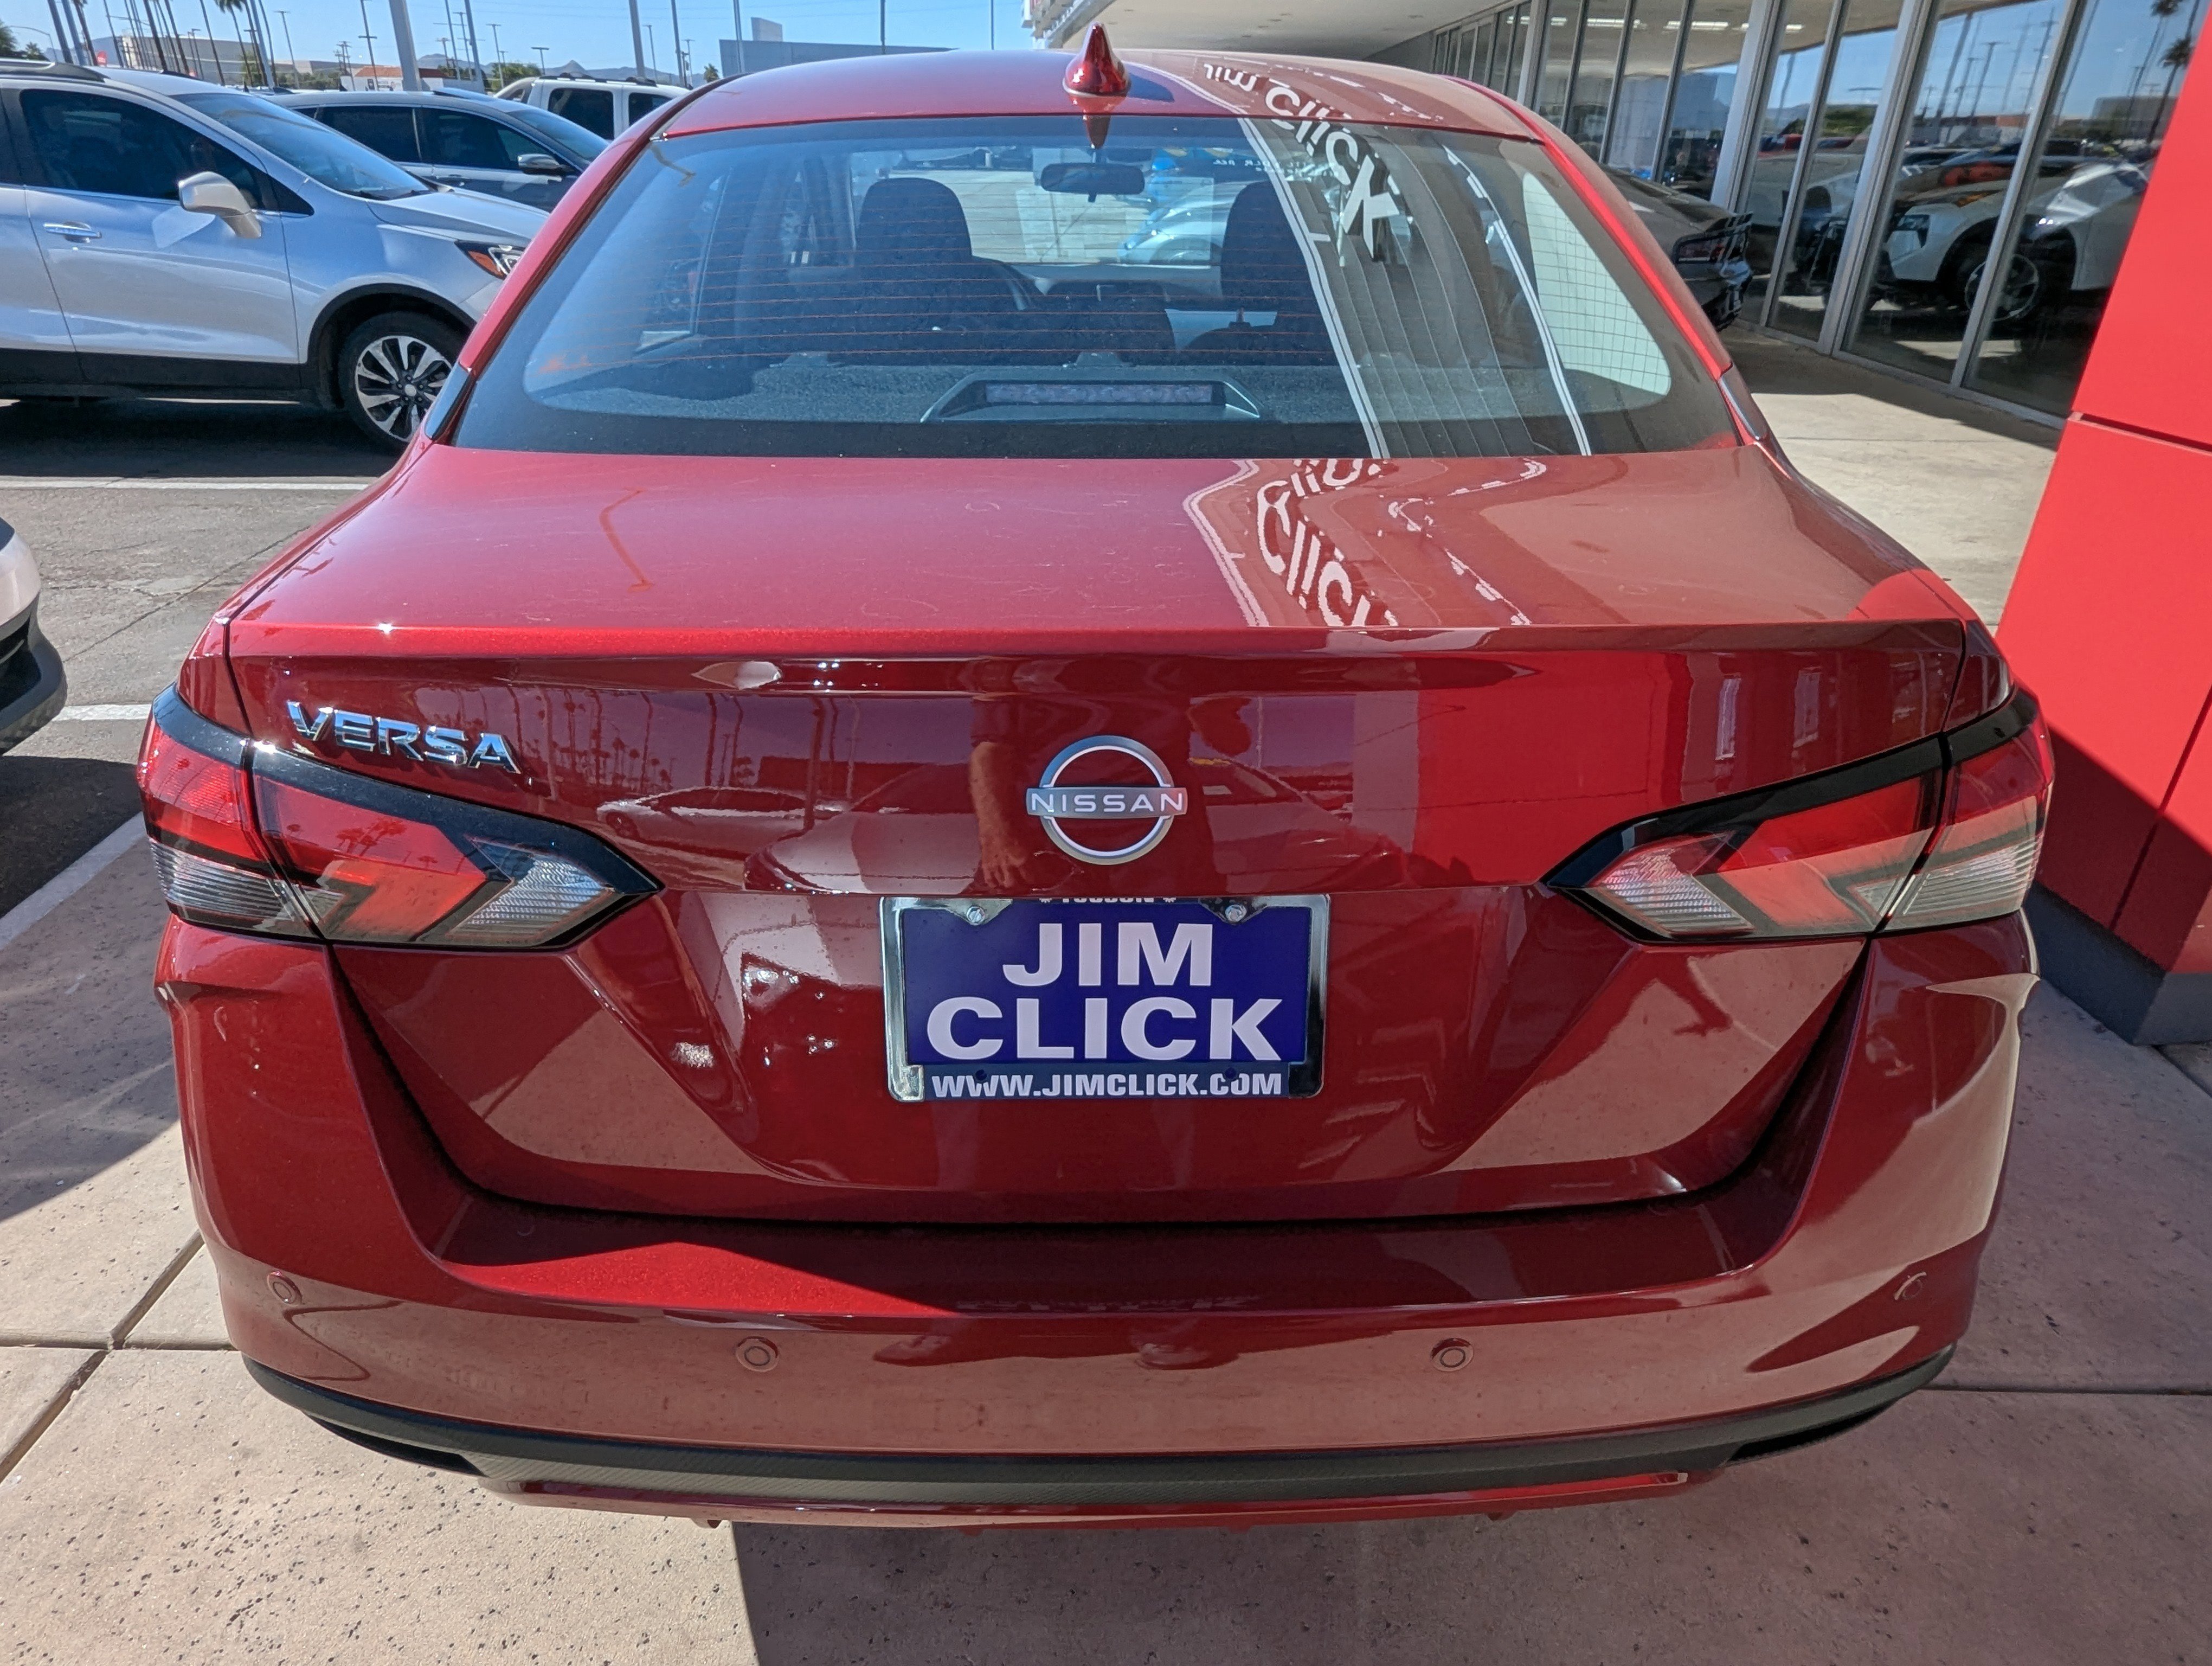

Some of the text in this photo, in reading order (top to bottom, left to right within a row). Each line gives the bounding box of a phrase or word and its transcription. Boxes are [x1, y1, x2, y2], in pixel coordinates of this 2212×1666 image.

[287, 701, 522, 774] VERSA
[1031, 793, 1182, 812] NISSAN
[1002, 922, 1213, 987] JIM
[927, 996, 1282, 1061] CLICK
[931, 1073, 1282, 1097] WWW.JIMCLICK.COM
